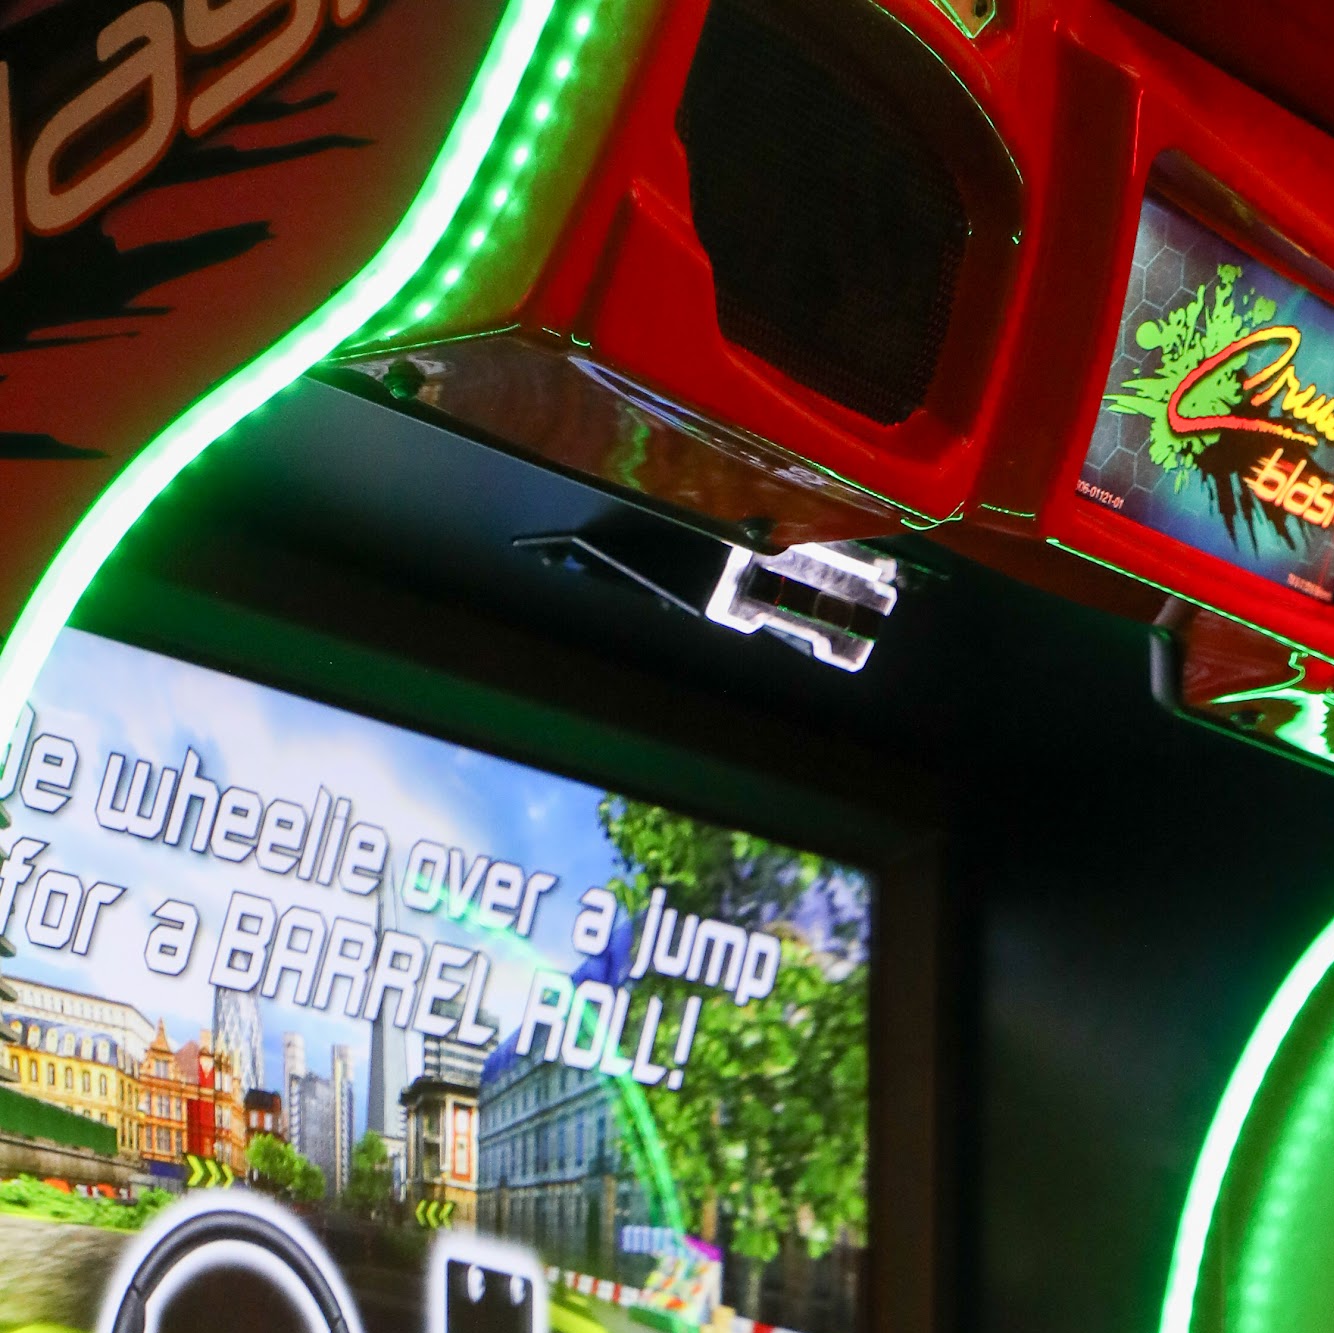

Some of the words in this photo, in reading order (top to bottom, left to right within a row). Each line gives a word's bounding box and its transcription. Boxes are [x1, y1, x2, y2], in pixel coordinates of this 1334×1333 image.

[0, 835, 127, 957] for
[144, 898, 198, 976] a
[210, 890, 500, 1046] BARREL
[515, 966, 702, 1092] ROLL!
[95, 746, 388, 895] wheelie
[402, 838, 557, 938] over
[572, 889, 617, 955] a
